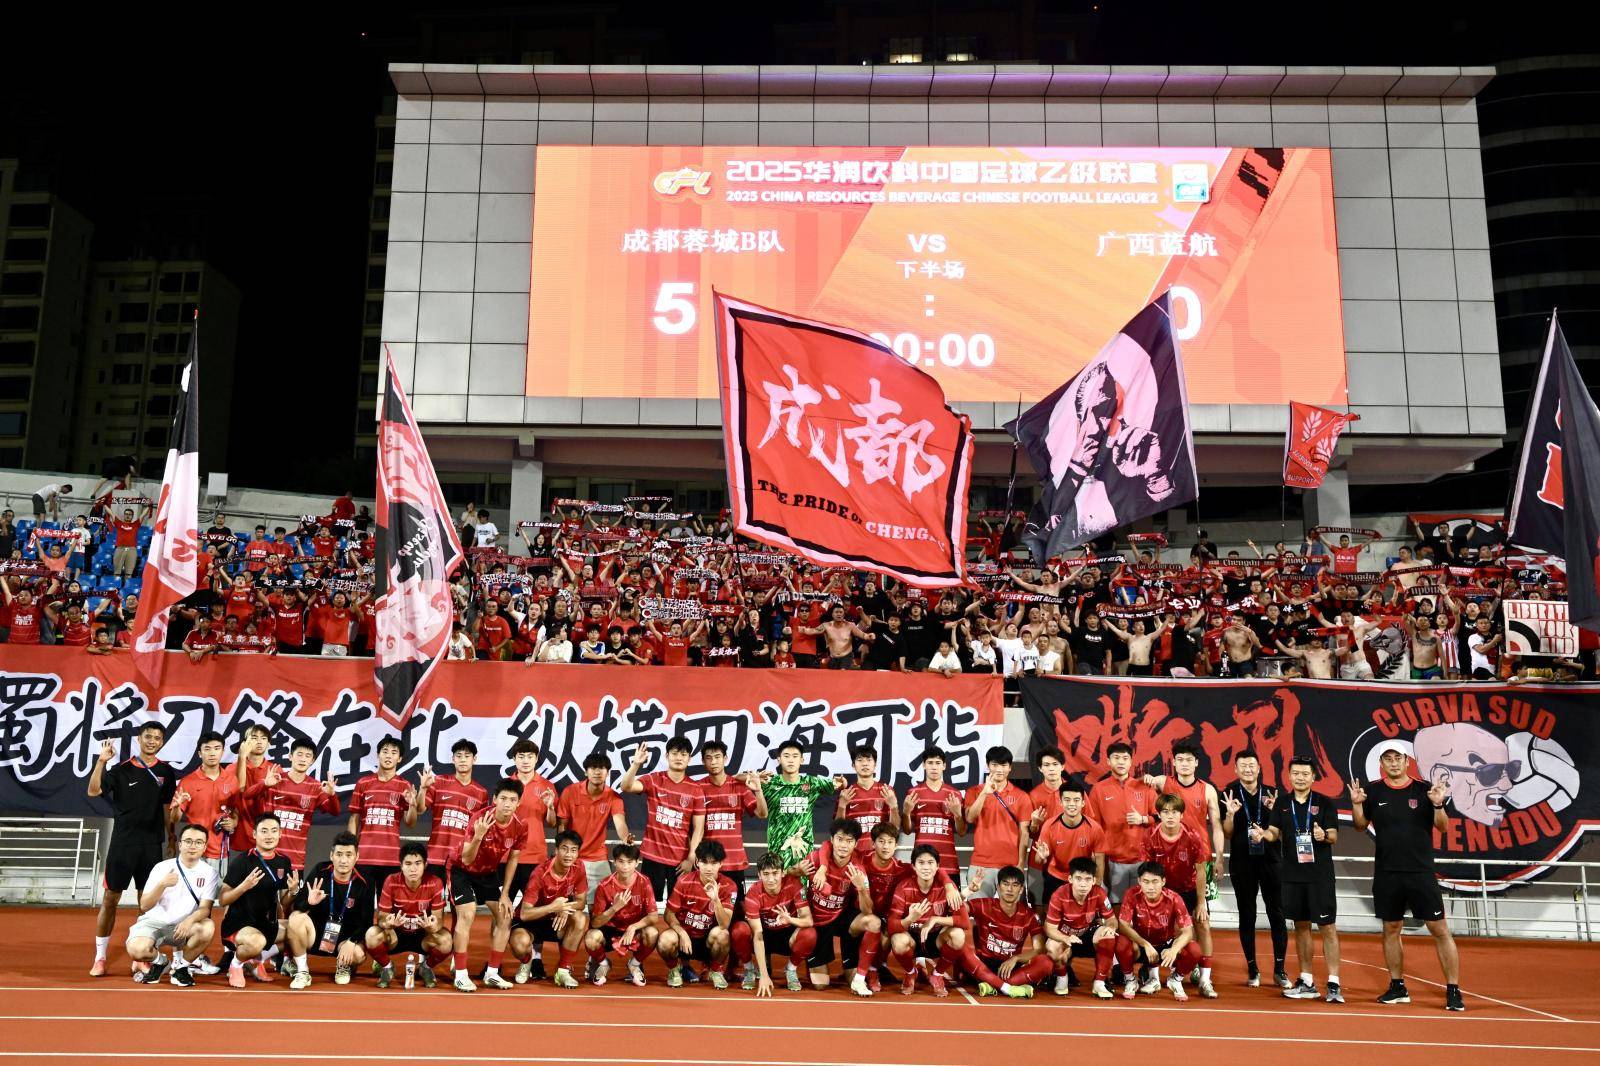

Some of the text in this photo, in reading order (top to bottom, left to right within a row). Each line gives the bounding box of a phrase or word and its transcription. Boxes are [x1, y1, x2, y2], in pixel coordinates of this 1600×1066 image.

[726, 190, 1159, 204] 2025 CHINA RESOURCES BEVERAGE CHINESE FOOTBALL LEAGUE2
[620, 228, 785, 254] 成都蓉城B队
[907, 233, 947, 253] VS
[1096, 231, 1219, 257] 广西蓝航
[896, 260, 966, 280] 下半场
[652, 281, 697, 336] 5
[869, 332, 995, 368] 0:00
[758, 364, 946, 504] 成都
[757, 479, 788, 505] THE
[793, 493, 850, 519] PRIDE
[865, 520, 946, 553] CHENG
[1222, 558, 1260, 568] Chengdu
[1000, 593, 1065, 604] NEVER FIGHT ALONE
[1372, 693, 1557, 741] CURVA SUD
[1432, 799, 1563, 853] ENGDU
